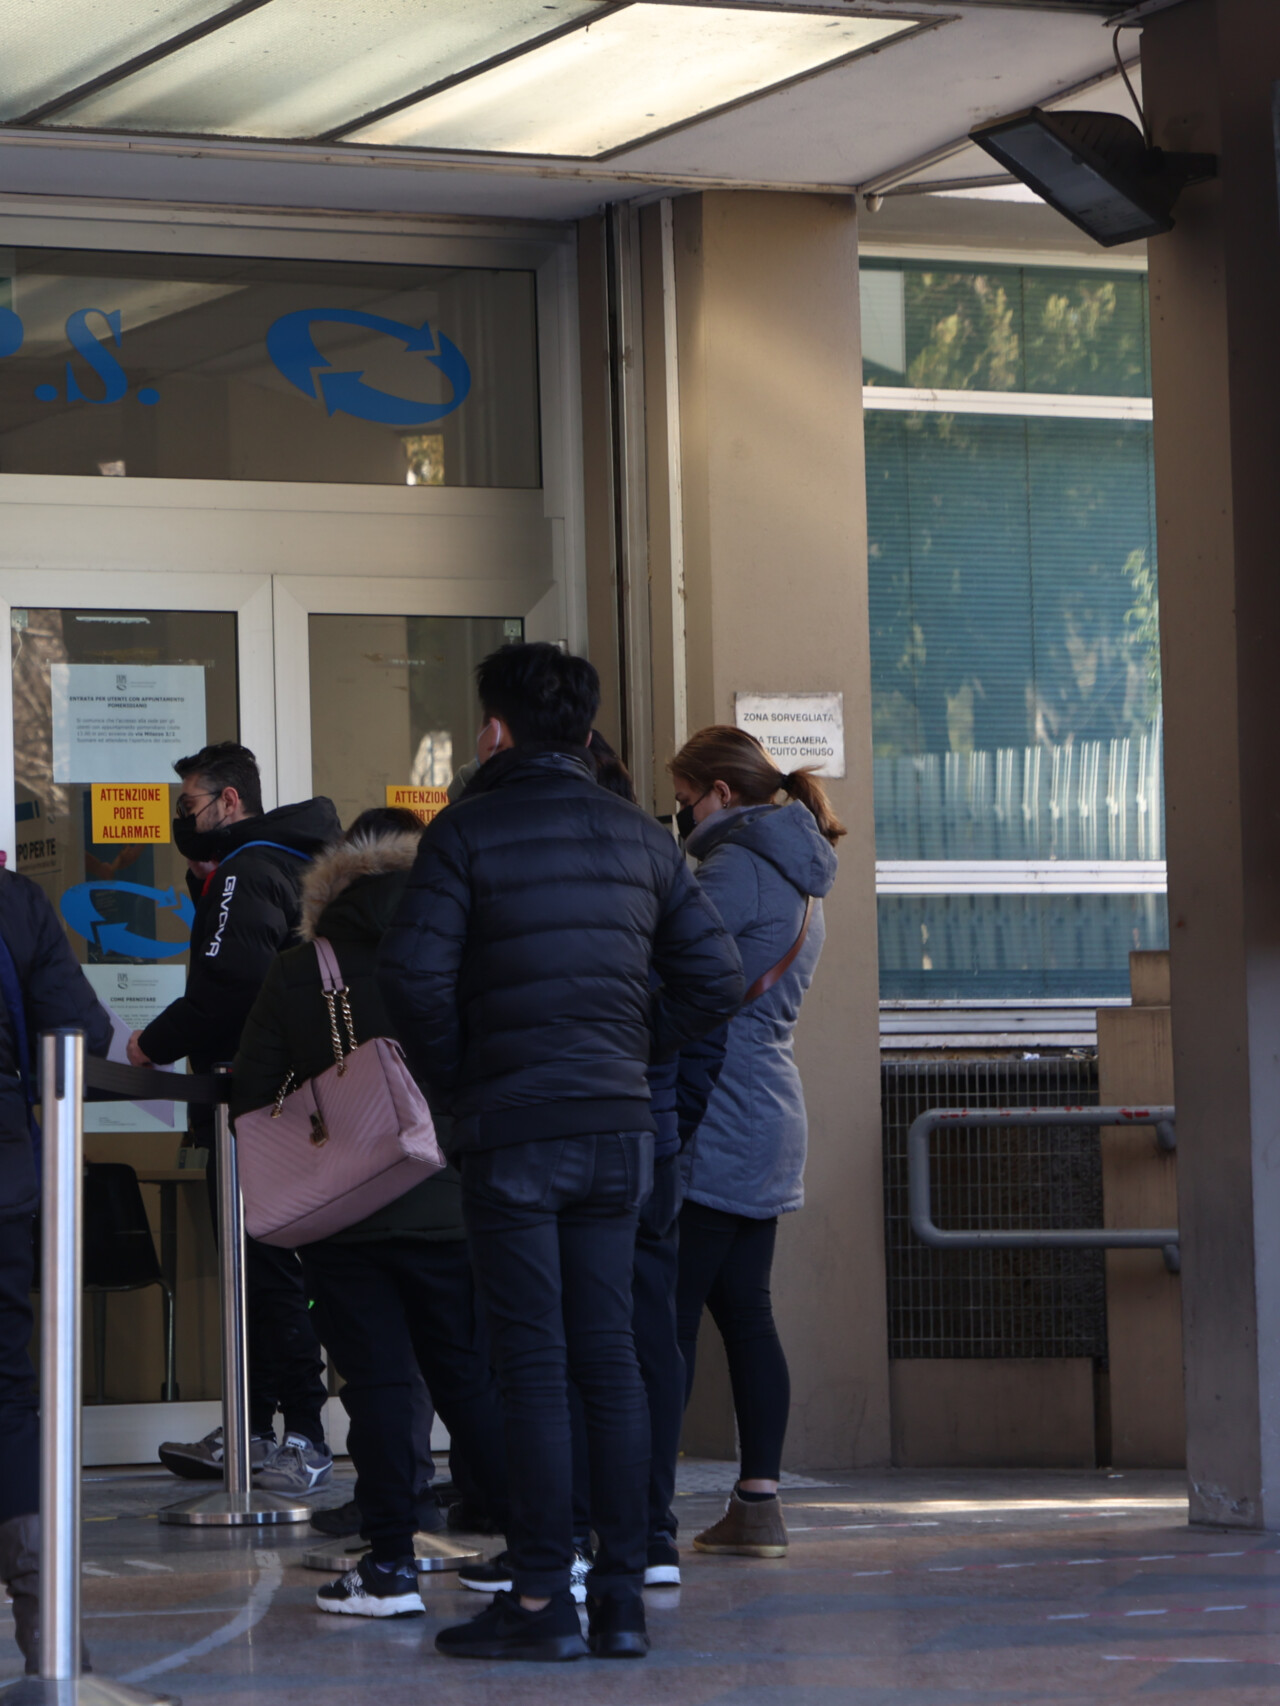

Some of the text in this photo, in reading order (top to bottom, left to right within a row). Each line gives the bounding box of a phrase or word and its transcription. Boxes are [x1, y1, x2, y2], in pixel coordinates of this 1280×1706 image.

[744, 713, 833, 722] ZONA SORVEGLIATA
[767, 736, 828, 745] TELECAMERA
[800, 747, 833, 756] CHIUSO
[100, 788, 160, 801] ATTENZIONE
[395, 791, 448, 803] ATTENZION
[113, 807, 144, 820] PORTE
[102, 826, 161, 839] ALLARMATE
[205, 876, 236, 957] GIVOVA
